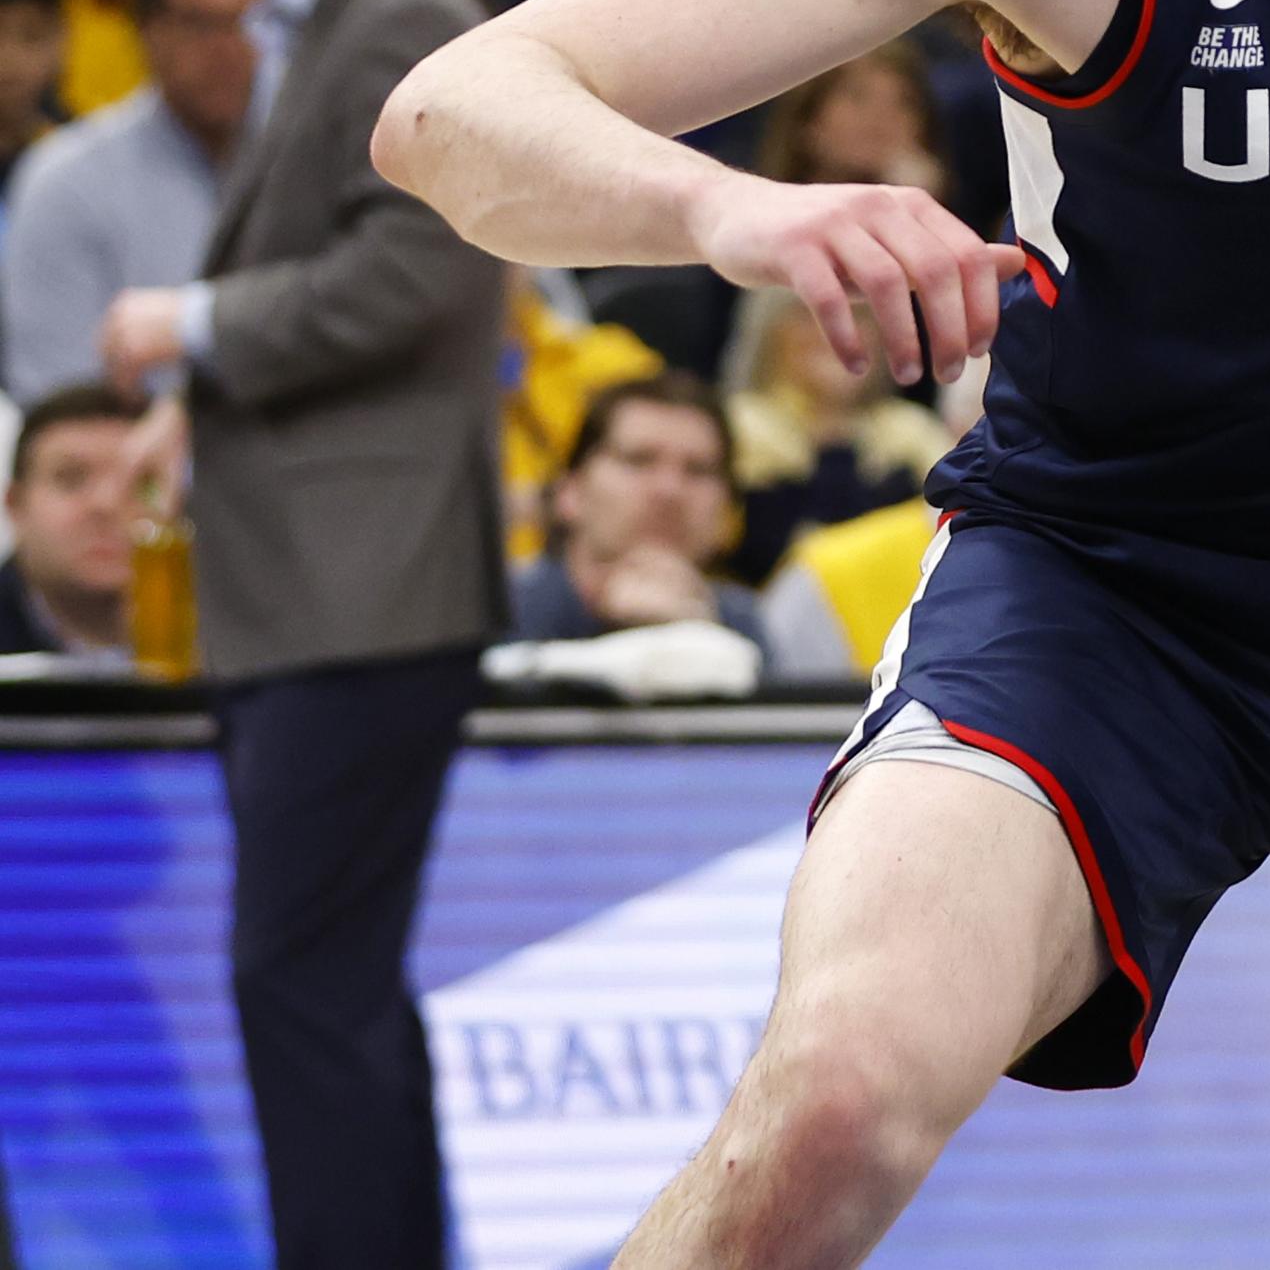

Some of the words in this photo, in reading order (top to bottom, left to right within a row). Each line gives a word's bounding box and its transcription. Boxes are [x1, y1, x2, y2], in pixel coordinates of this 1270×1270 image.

[1198, 26, 1226, 47] BE
[1231, 25, 1261, 47] THE
[1191, 45, 1264, 68] CHANGE
[462, 1014, 768, 1120] BAIR
